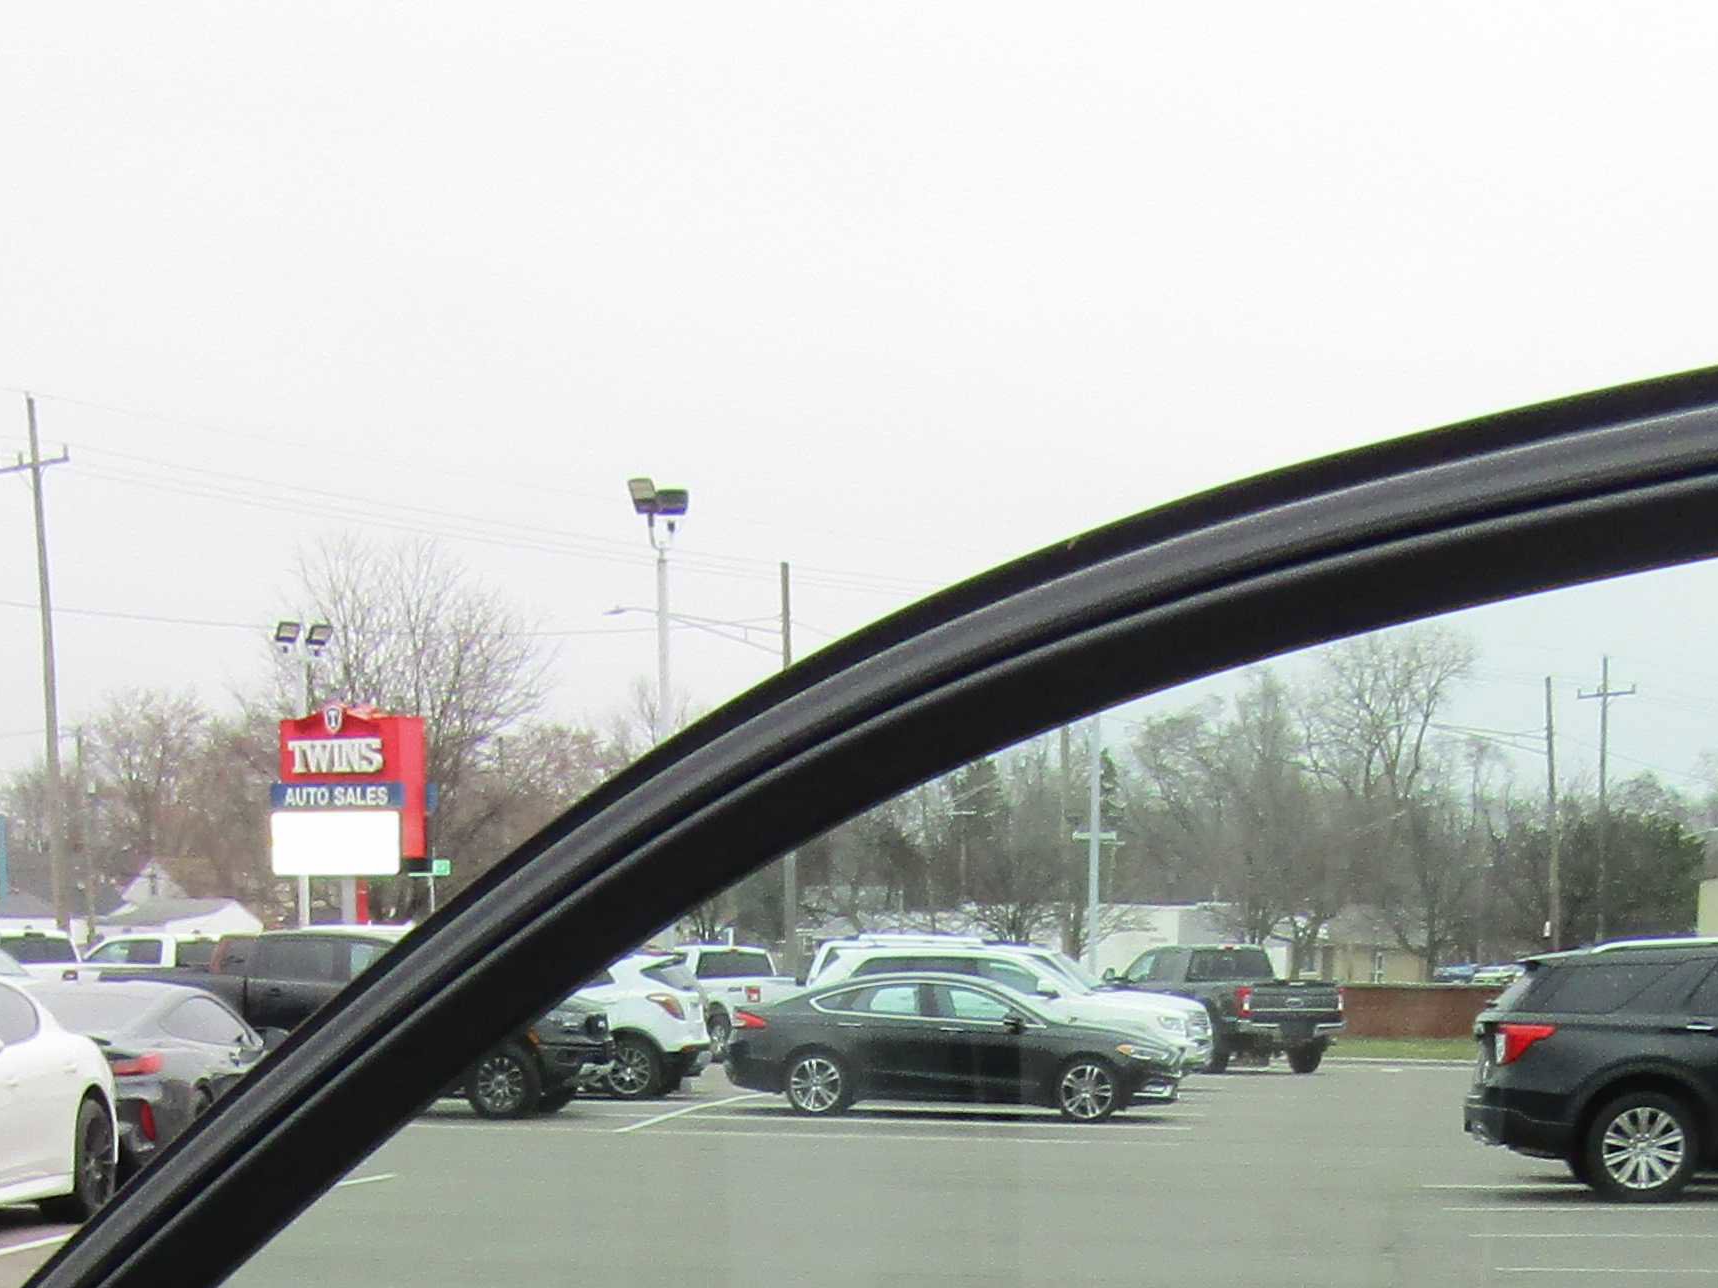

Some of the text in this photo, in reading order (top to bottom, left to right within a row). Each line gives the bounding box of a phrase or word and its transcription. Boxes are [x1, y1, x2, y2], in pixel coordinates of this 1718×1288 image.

[287, 737, 384, 773] TWINS
[284, 786, 388, 806] AUTO SALES
